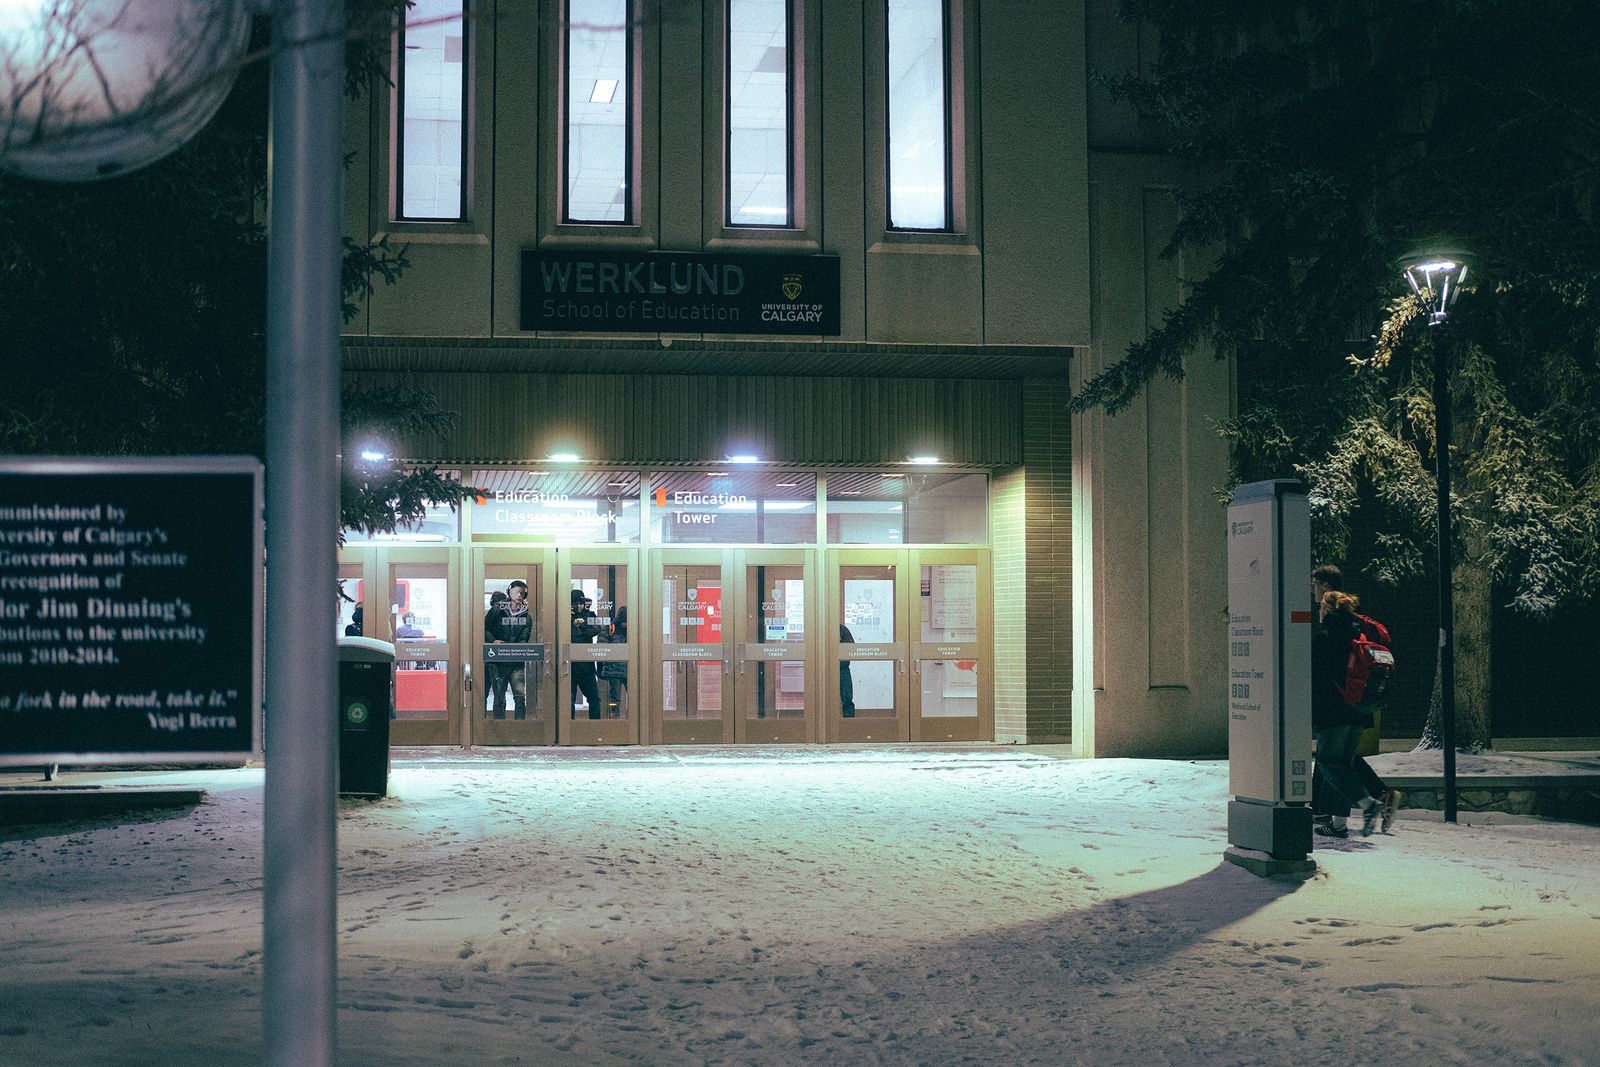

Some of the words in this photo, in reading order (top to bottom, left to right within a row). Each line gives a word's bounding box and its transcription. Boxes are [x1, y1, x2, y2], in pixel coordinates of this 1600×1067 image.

[541, 261, 744, 295] WERKLUND
[543, 299, 609, 318] School
[616, 300, 637, 319] of
[642, 300, 739, 320] Education
[761, 310, 823, 322] CALGARY
[495, 490, 569, 504] Education
[674, 491, 747, 504] Education
[106, 504, 126, 523] by
[495, 509, 572, 523] Classroom
[576, 510, 617, 523] Block
[674, 511, 718, 524] Tower
[62, 527, 82, 544] of
[84, 526, 168, 546] Calgary's
[92, 550, 125, 567] and
[130, 550, 188, 566] Senate
[104, 572, 124, 590] of
[36, 597, 79, 618] Jim
[87, 597, 192, 621] Dinning's
[66, 625, 85, 641] to
[89, 624, 116, 641] the
[121, 624, 206, 644] university
[14, 689, 53, 711] fork
[58, 690, 77, 708] in
[82, 689, 111, 708] the
[115, 689, 161, 709] road,
[166, 689, 204, 708] take
[147, 712, 184, 731] Yogi
[189, 712, 237, 728] Berra
